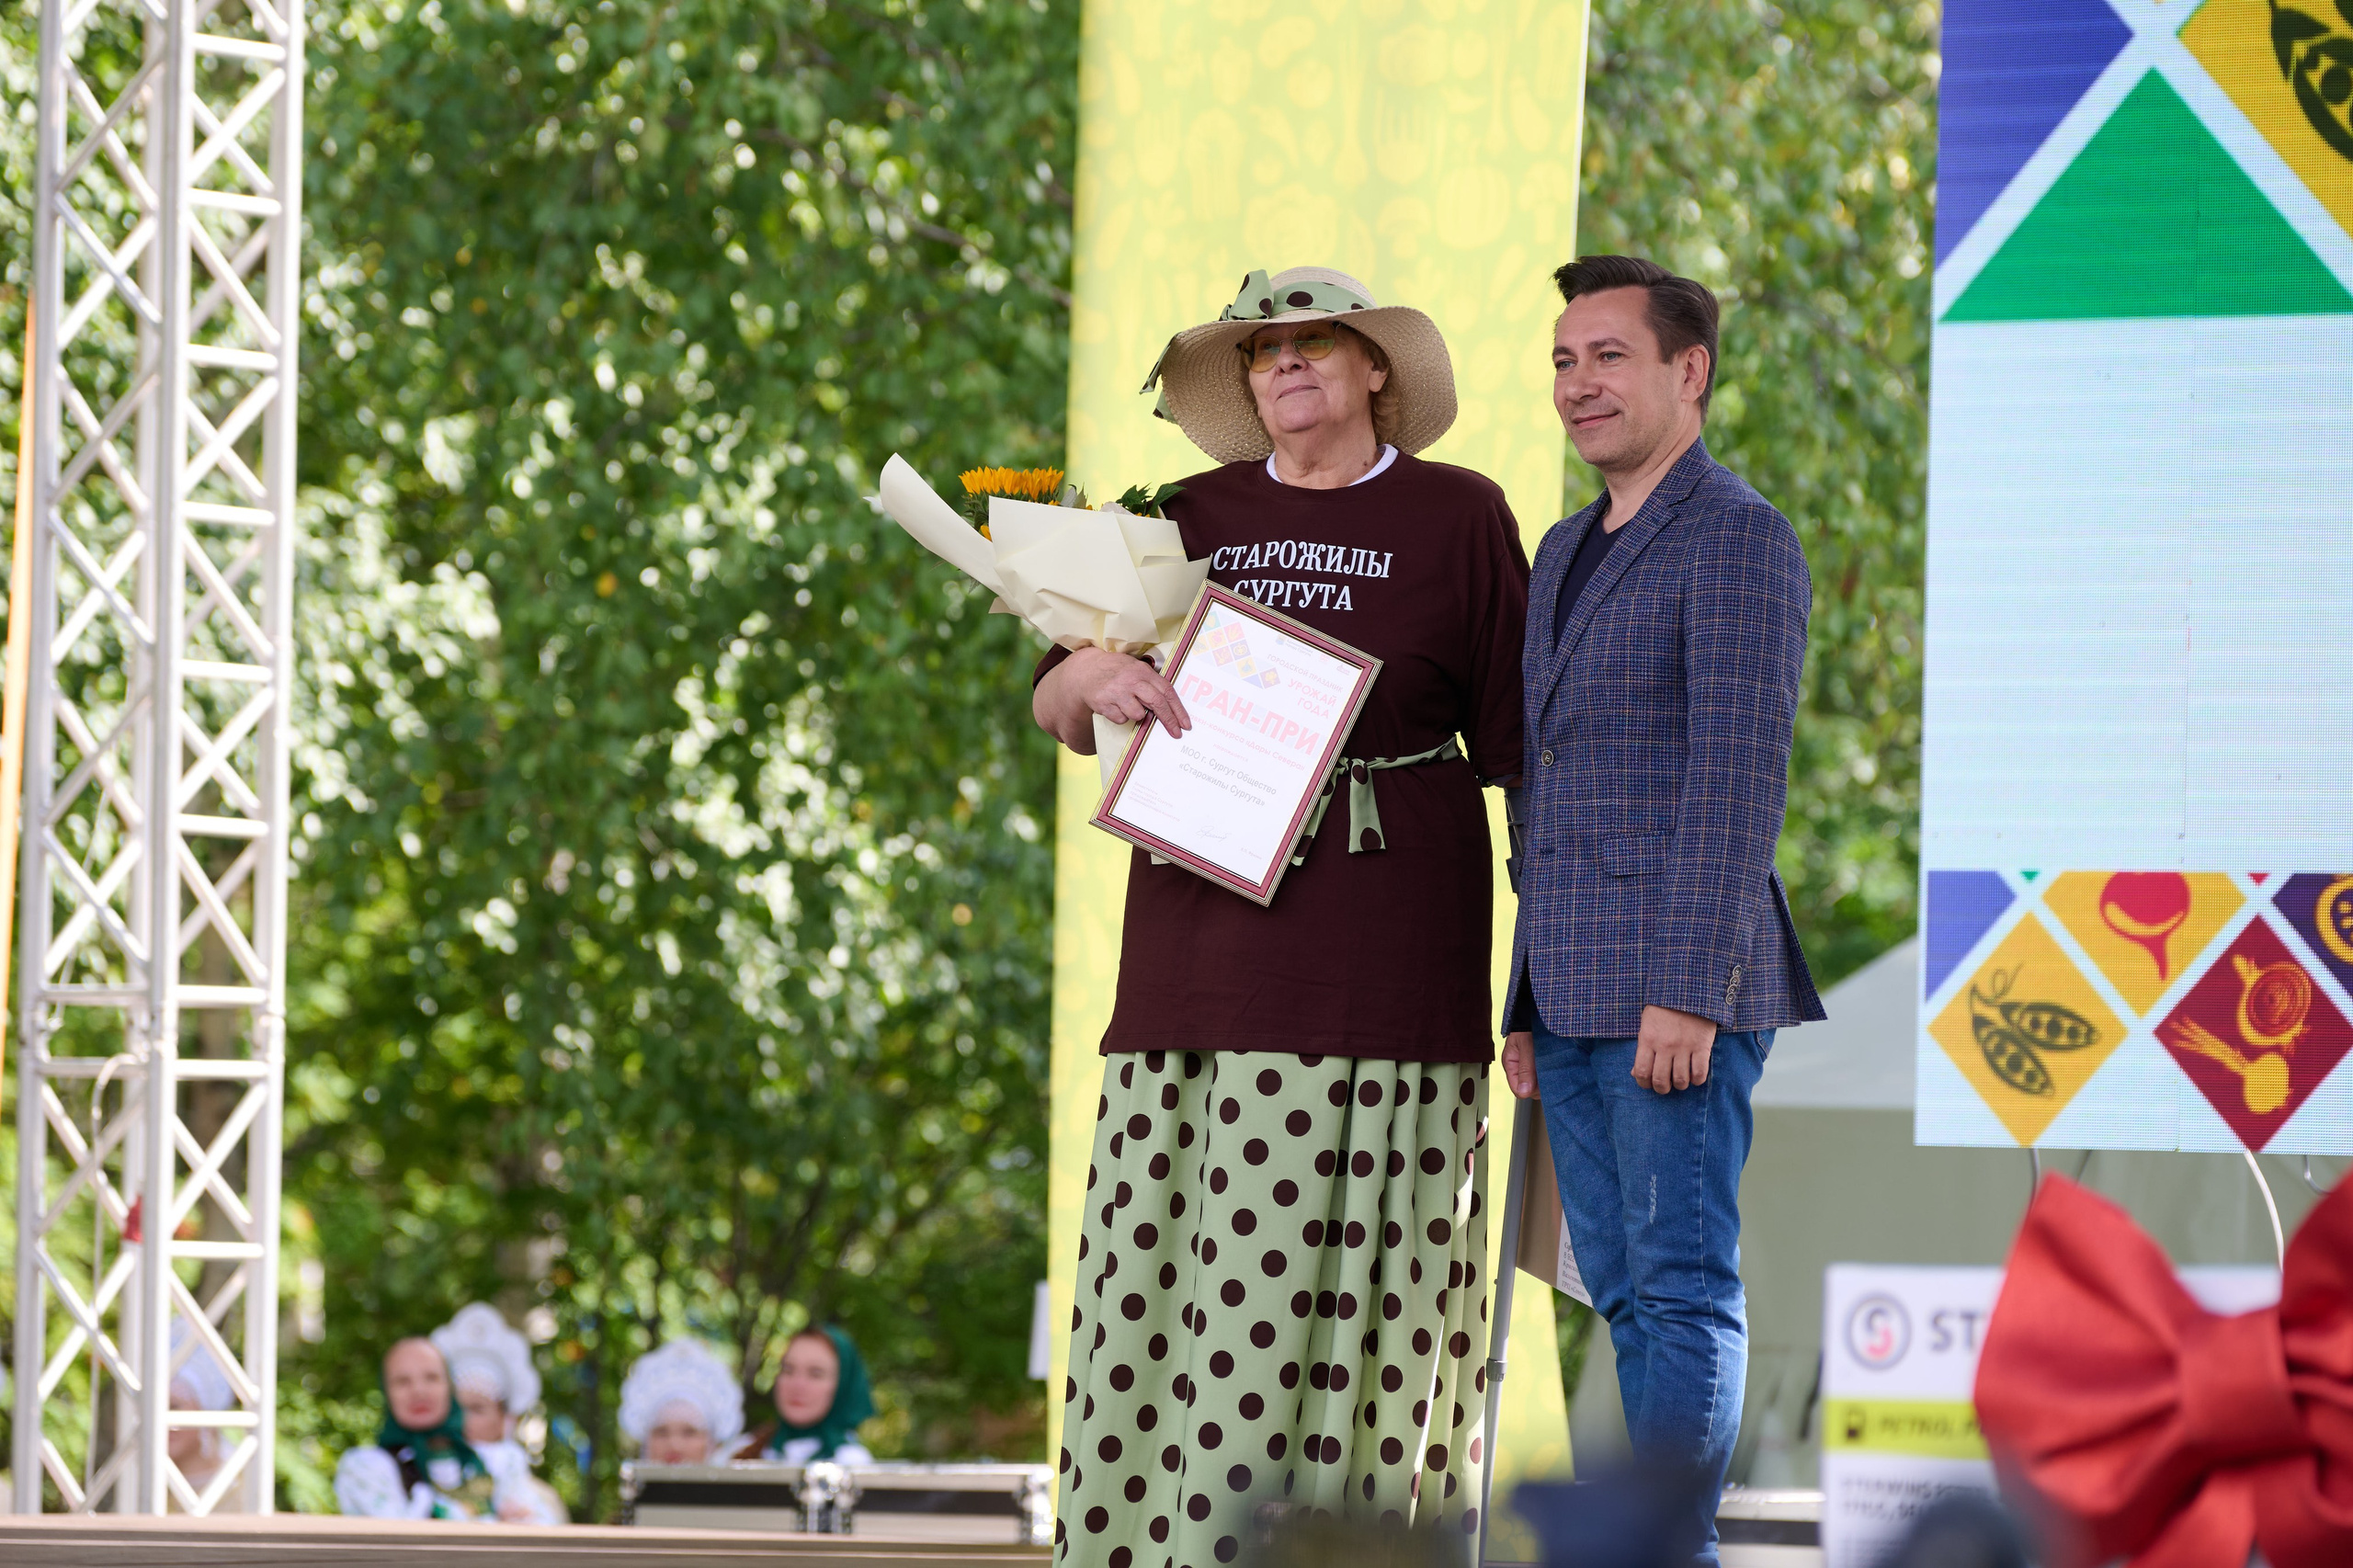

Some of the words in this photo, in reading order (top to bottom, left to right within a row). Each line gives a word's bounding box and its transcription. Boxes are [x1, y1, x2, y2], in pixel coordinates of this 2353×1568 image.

[1212, 540, 1393, 578] СТАРОЖИЛЫ
[1233, 579, 1354, 611] СУРГУТА
[1266, 653, 1309, 676] ГОРОДСКОЙ
[1308, 672, 1343, 693] ПРАЗДНИК
[1287, 677, 1336, 707] УРОЖАЙ
[1177, 673, 1320, 756] ГРАН-ПРИ
[1296, 697, 1329, 719] ГОДА
[1188, 713, 1245, 744] авки-конкурса
[1271, 750, 1305, 771] Севера»
[1178, 762, 1229, 790] «Старожилы
[1229, 784, 1265, 806] Сургута»
[1179, 744, 1201, 760] МОО
[1208, 757, 1236, 776] Сургут
[1235, 770, 1277, 795] Общество
[1929, 1308, 1986, 1352] ST
